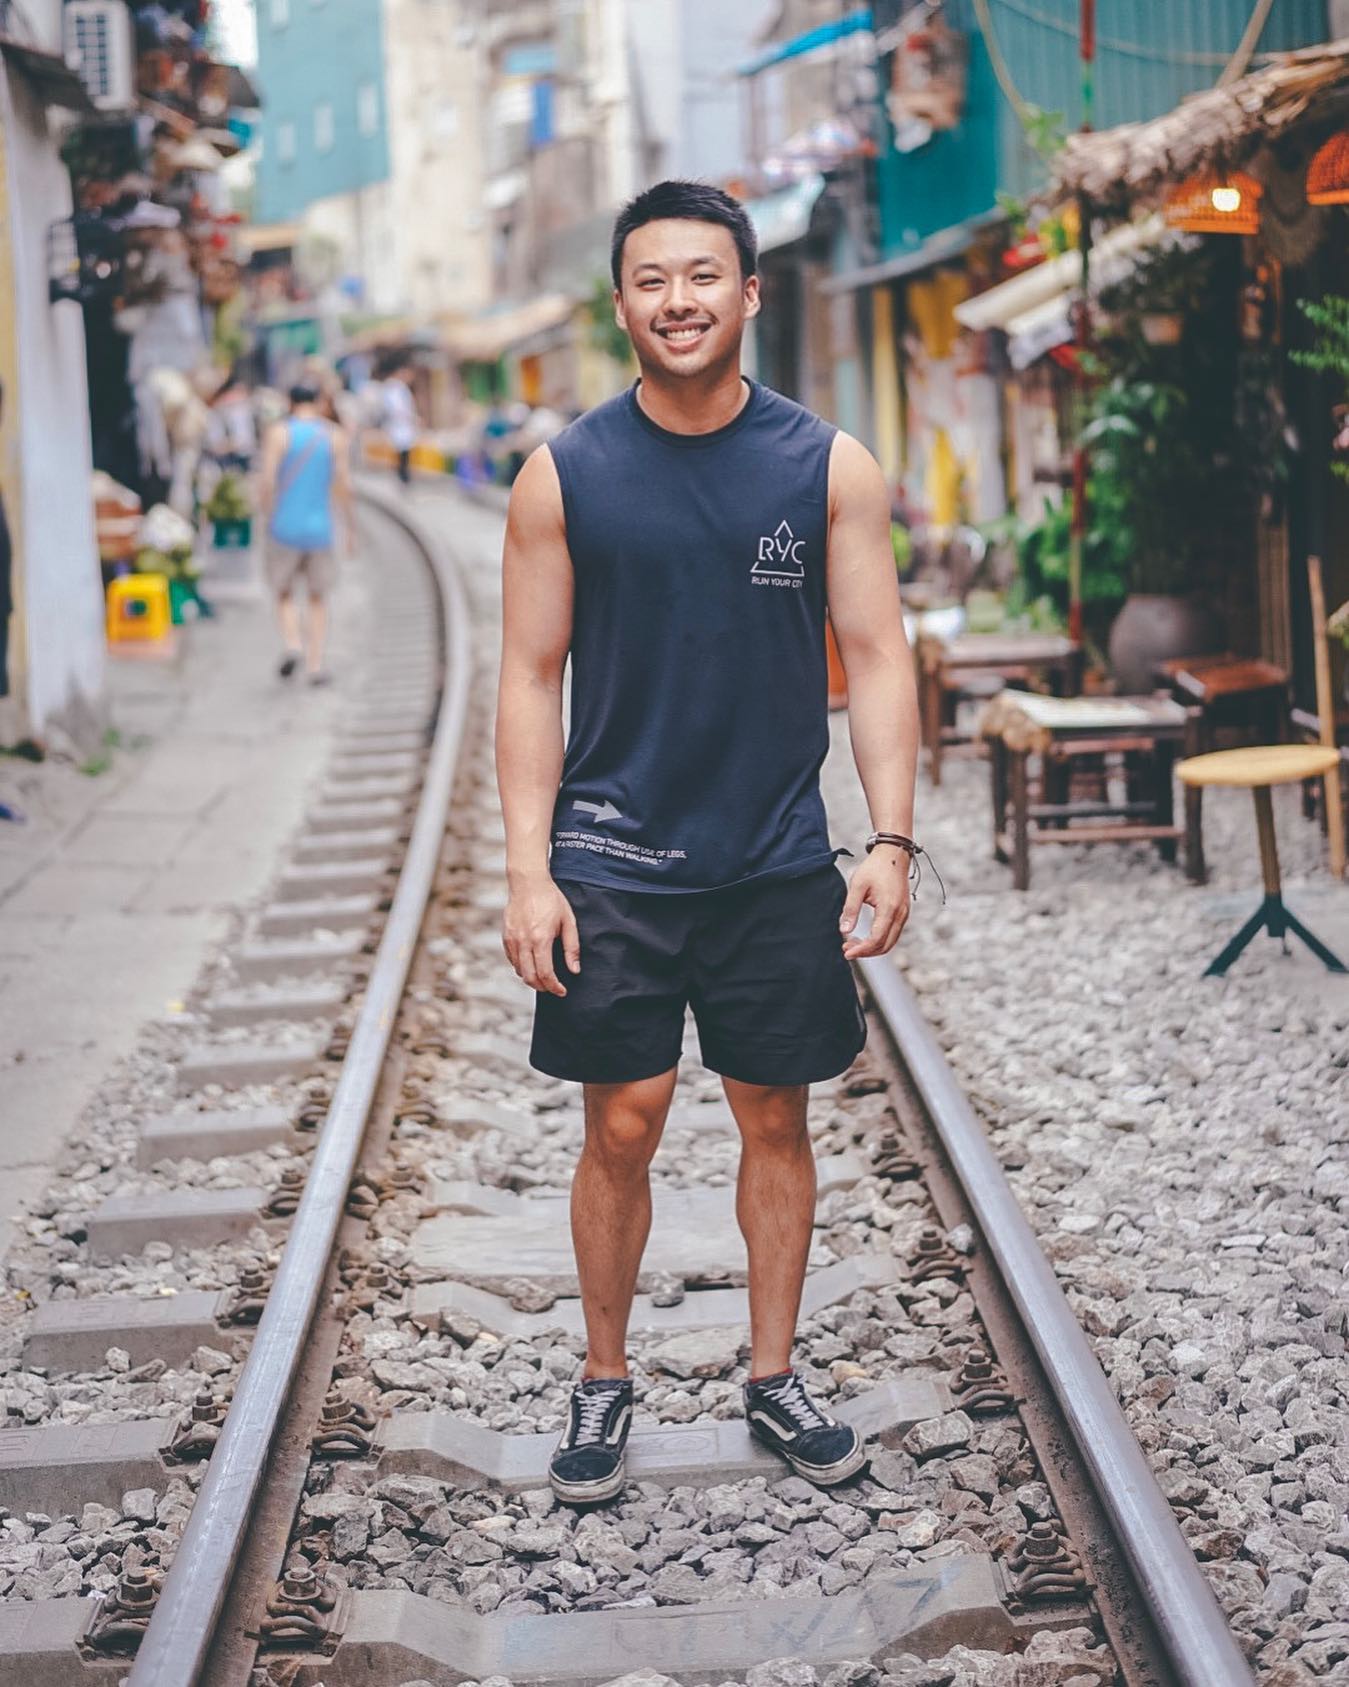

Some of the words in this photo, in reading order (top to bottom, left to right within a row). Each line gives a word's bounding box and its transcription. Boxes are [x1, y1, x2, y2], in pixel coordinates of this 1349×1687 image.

[758, 536, 806, 564] RYC
[751, 576, 770, 585] RUN
[771, 577, 791, 587] YOUR
[579, 833, 605, 844] MOTION
[607, 838, 640, 853] THROUGH
[641, 846, 655, 857] USE
[586, 842, 604, 853] PACE
[605, 847, 625, 857] THAN
